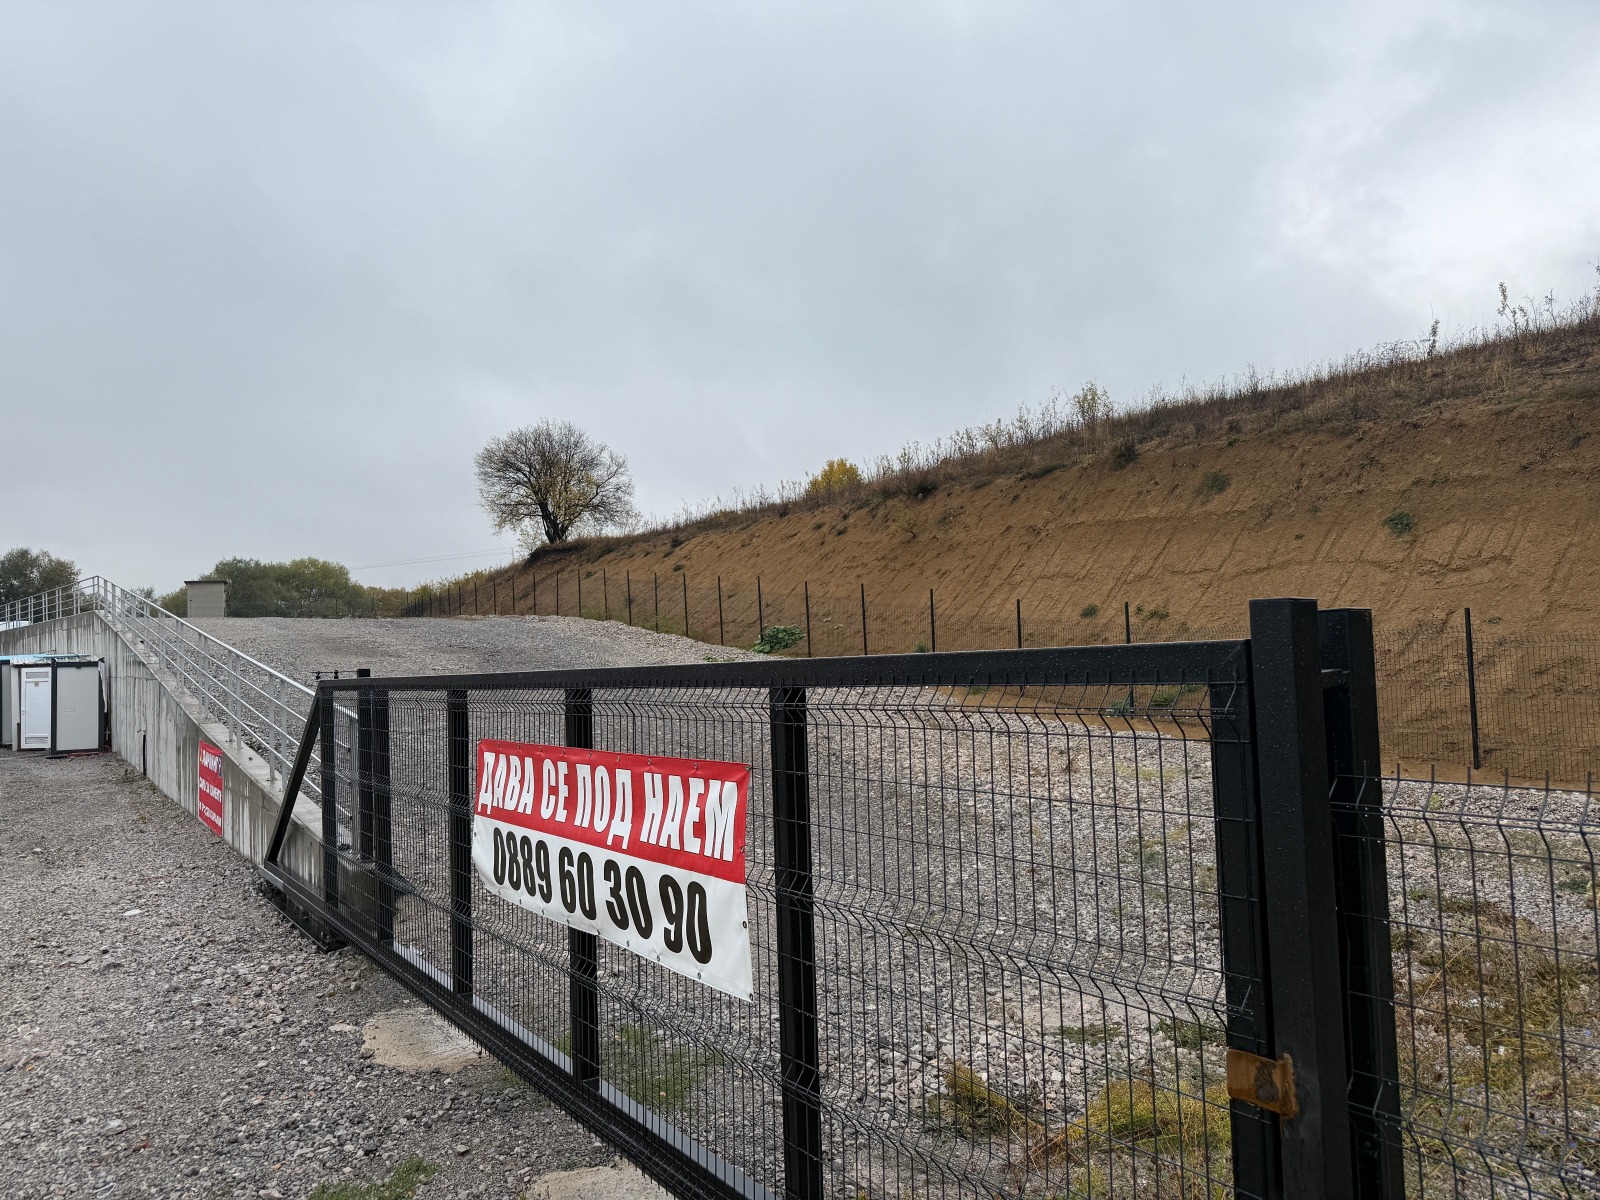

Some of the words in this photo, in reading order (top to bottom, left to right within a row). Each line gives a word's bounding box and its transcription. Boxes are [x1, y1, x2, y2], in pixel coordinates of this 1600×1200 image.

[478, 751, 534, 815] ДАВА
[540, 758, 569, 823] СЕ
[574, 763, 633, 850] ПОД
[639, 772, 738, 862] НАЕМ
[493, 827, 553, 904] 0889
[558, 846, 597, 921] 60
[603, 859, 652, 940] 30
[658, 874, 713, 964] 90
